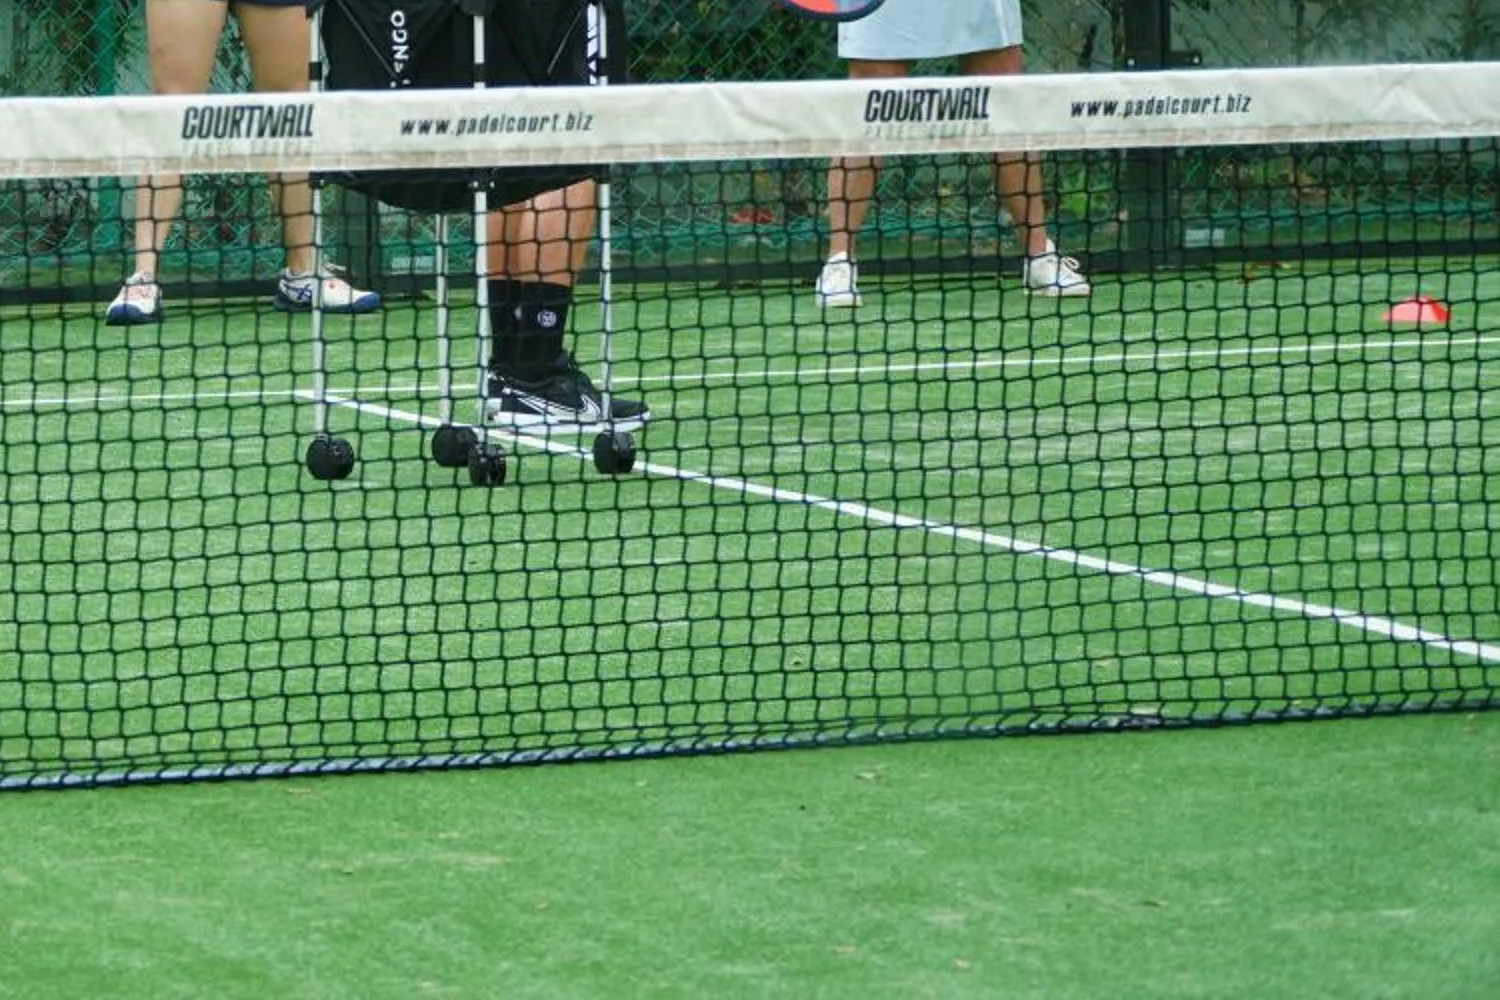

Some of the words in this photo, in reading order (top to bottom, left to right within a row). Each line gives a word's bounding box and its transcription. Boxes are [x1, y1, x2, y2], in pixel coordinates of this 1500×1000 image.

[863, 86, 991, 123] COURTWALL
[1070, 94, 1253, 119] www.padelcourt.biz
[181, 103, 314, 140] COURTWALL
[399, 113, 595, 137] www.padelcourt.biz
